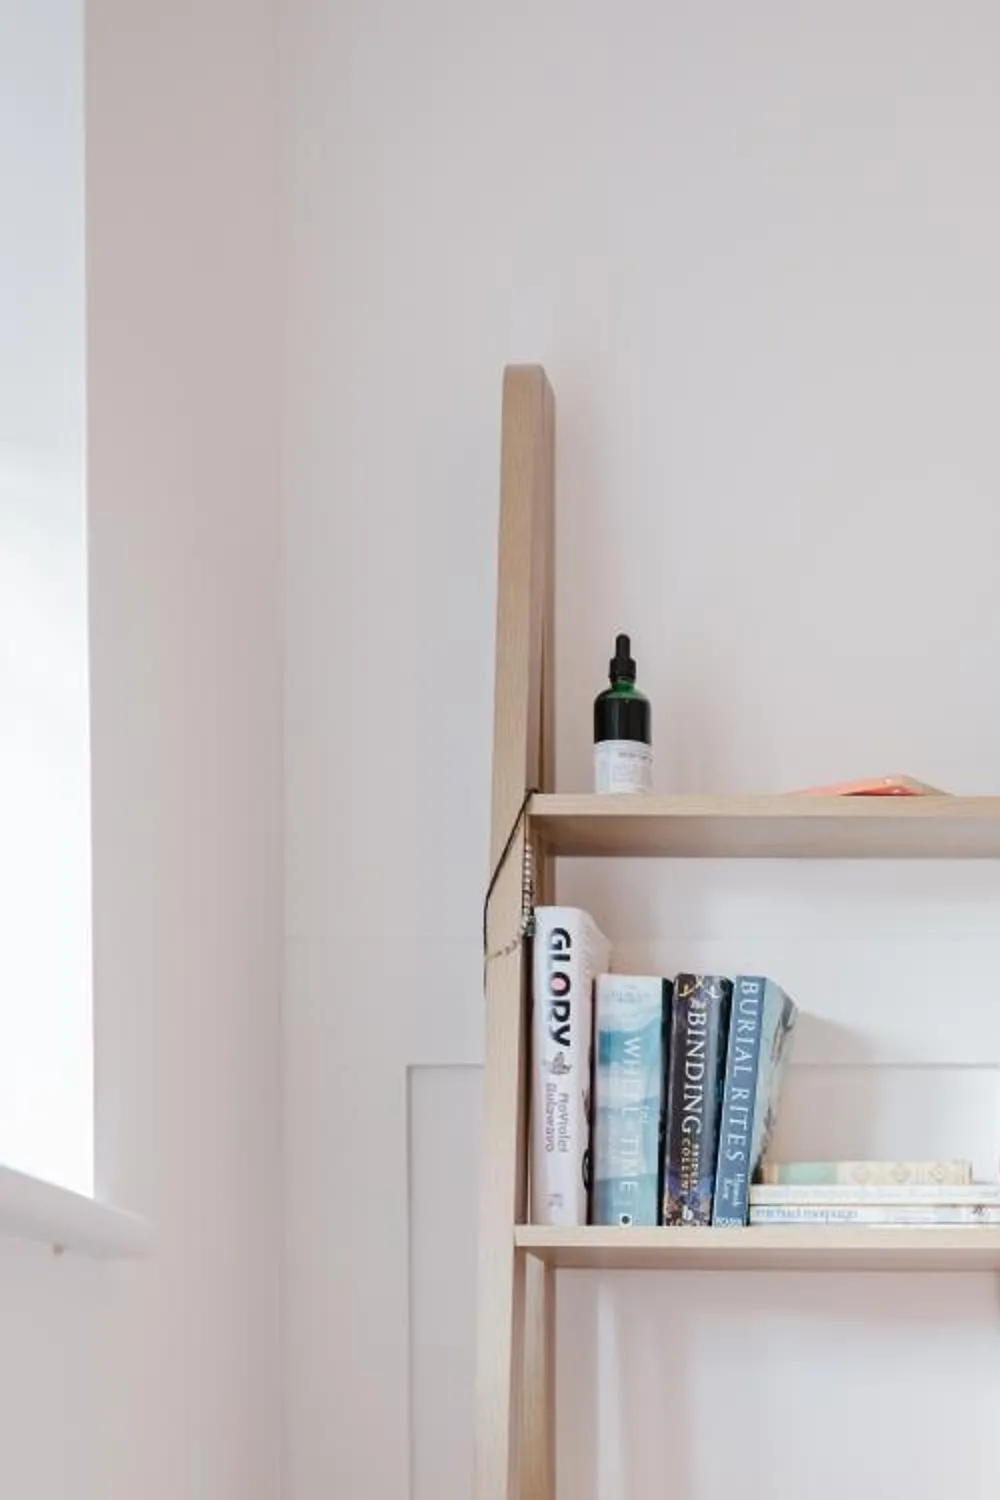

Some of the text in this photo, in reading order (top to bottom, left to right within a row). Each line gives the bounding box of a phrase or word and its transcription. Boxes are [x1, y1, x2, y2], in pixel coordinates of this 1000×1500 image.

[550, 927, 572, 1047] GLORY
[682, 1010, 707, 1134] BINDING
[725, 980, 758, 1161] BURIAL RITES
